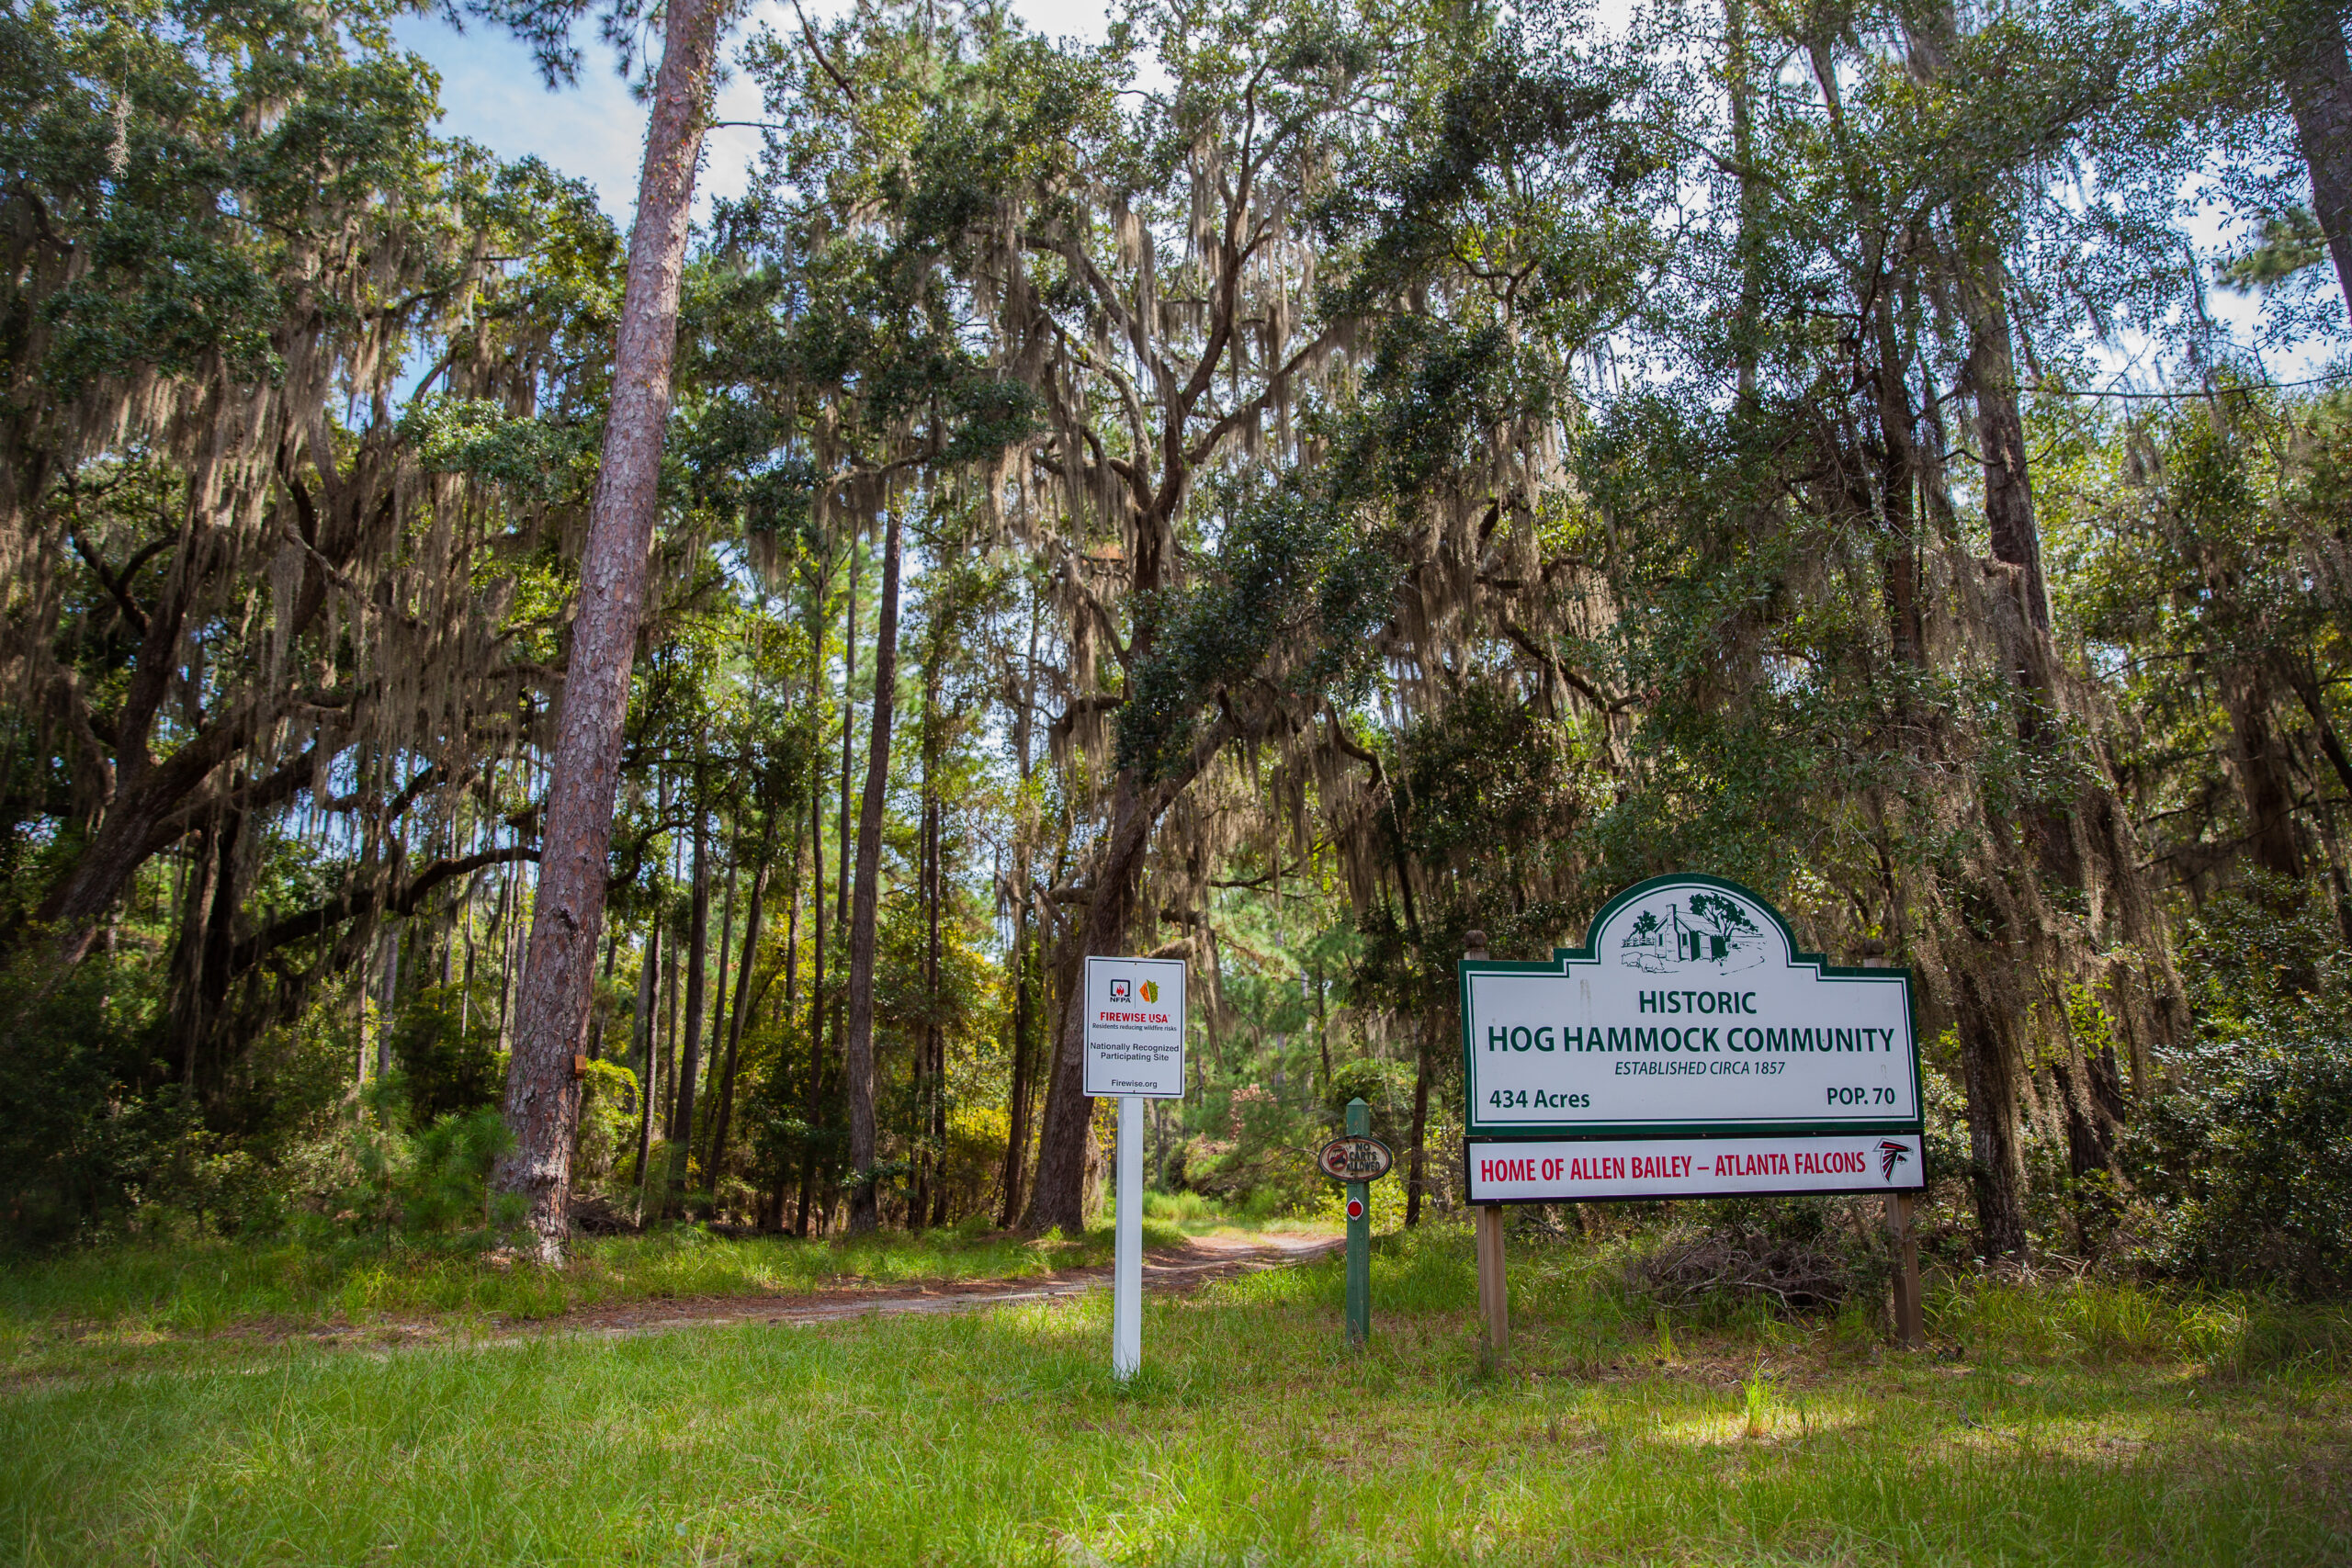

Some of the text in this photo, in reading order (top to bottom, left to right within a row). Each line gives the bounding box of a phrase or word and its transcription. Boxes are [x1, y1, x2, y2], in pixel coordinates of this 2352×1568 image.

[1639, 990, 1758, 1014] HISTORIC
[1101, 1012, 1147, 1022] FIREWISE
[1487, 1026, 1894, 1052] HOG HAMMOCK COMMUNITY
[1090, 1043, 1179, 1053] Nationally Recognized
[1101, 1053, 1151, 1062] Participating
[1614, 1061, 1785, 1076] ESTABLISHED CIRCA 1857
[1111, 1079, 1158, 1089] Firewise.org
[1489, 1089, 1590, 1109] 434 Acres
[1826, 1087, 1895, 1105] POP. 70
[1356, 1143, 1371, 1151] NO
[1350, 1152, 1377, 1161] CARTS
[1346, 1161, 1380, 1171] ALLOWED
[1481, 1159, 1536, 1182] HOME
[1542, 1158, 1565, 1180] OF
[1570, 1157, 1625, 1180] ALLEN
[1632, 1156, 1691, 1179] BAILEY
[1715, 1153, 1790, 1177] ATLANTA
[1795, 1151, 1866, 1175] FALCONS
